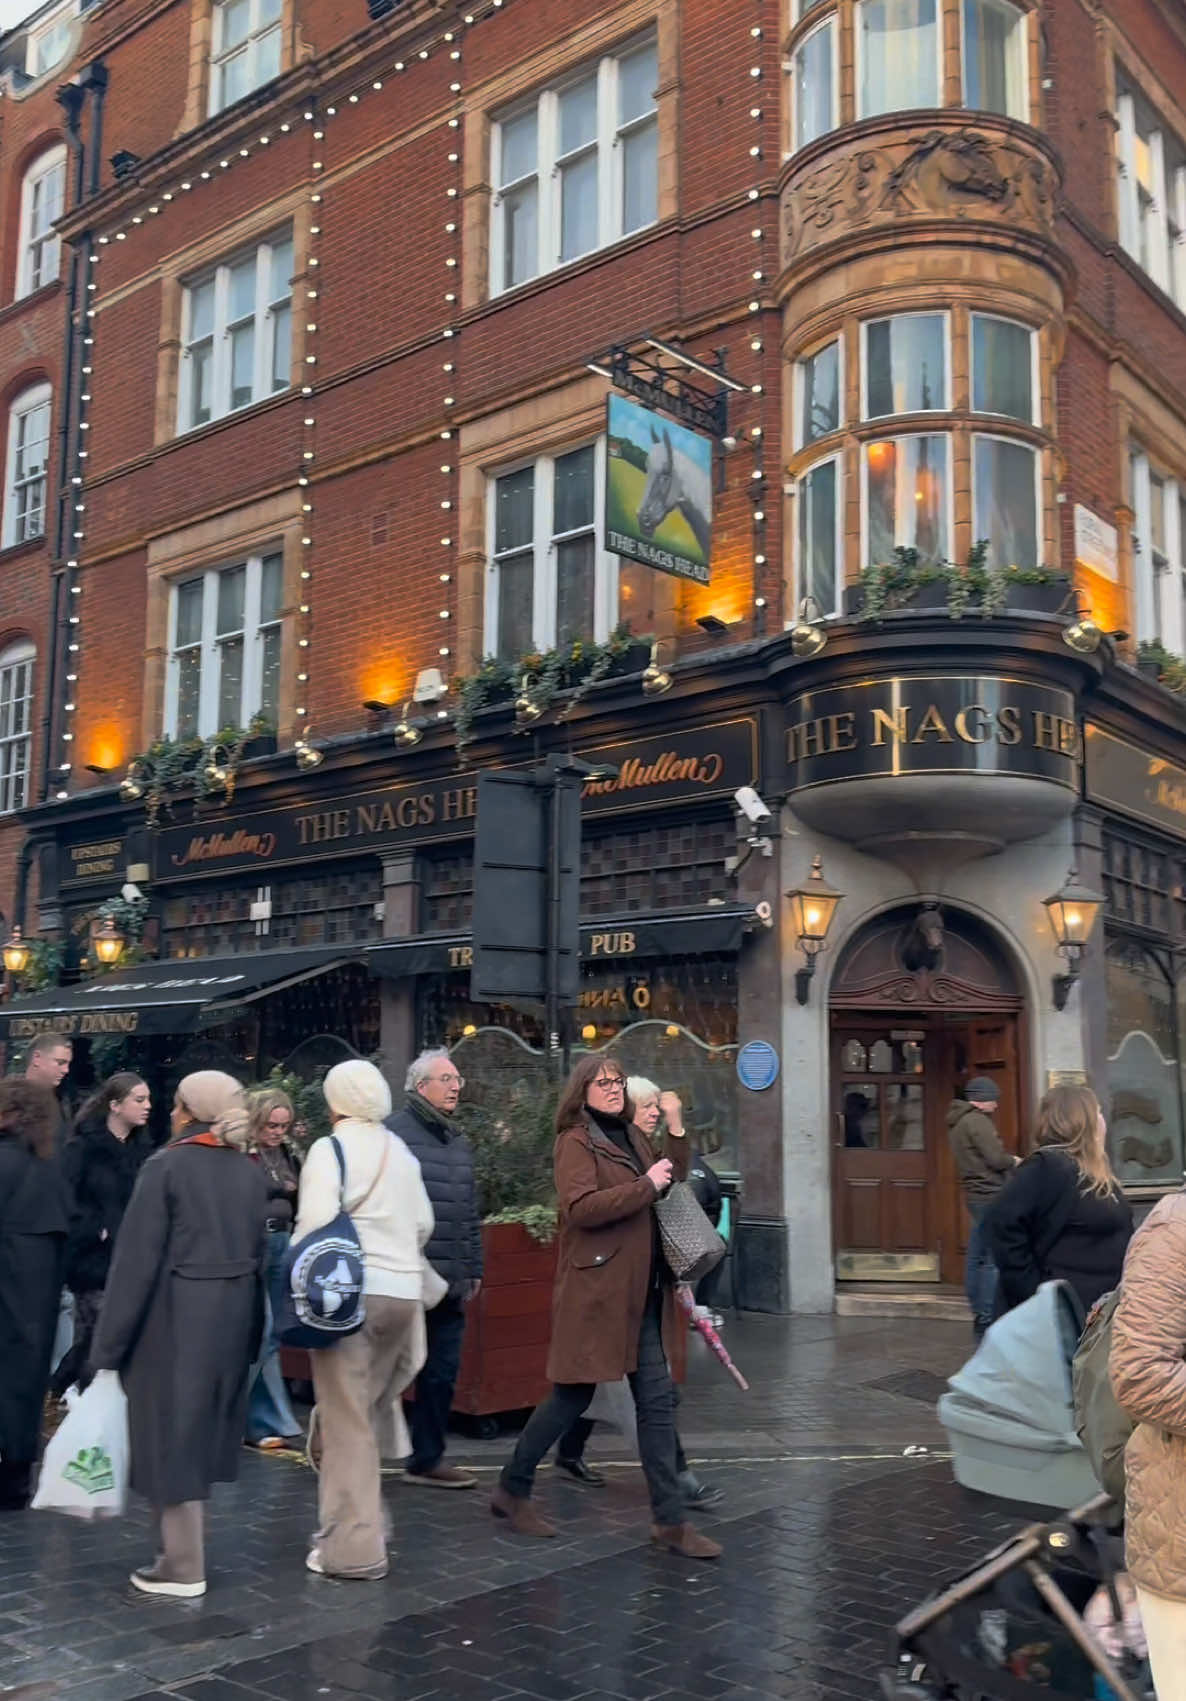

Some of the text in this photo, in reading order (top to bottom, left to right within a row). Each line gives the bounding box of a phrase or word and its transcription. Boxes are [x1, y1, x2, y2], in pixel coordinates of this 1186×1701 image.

[608, 531, 637, 553] THE
[638, 542, 674, 568] NAGS
[784, 712, 857, 763] THE
[870, 704, 1022, 745] NAGS
[296, 809, 350, 844] THE
[356, 794, 435, 835] NAGS
[171, 829, 276, 866] McMullen
[591, 932, 637, 956] PUB
[80, 1012, 138, 1033] DINING
